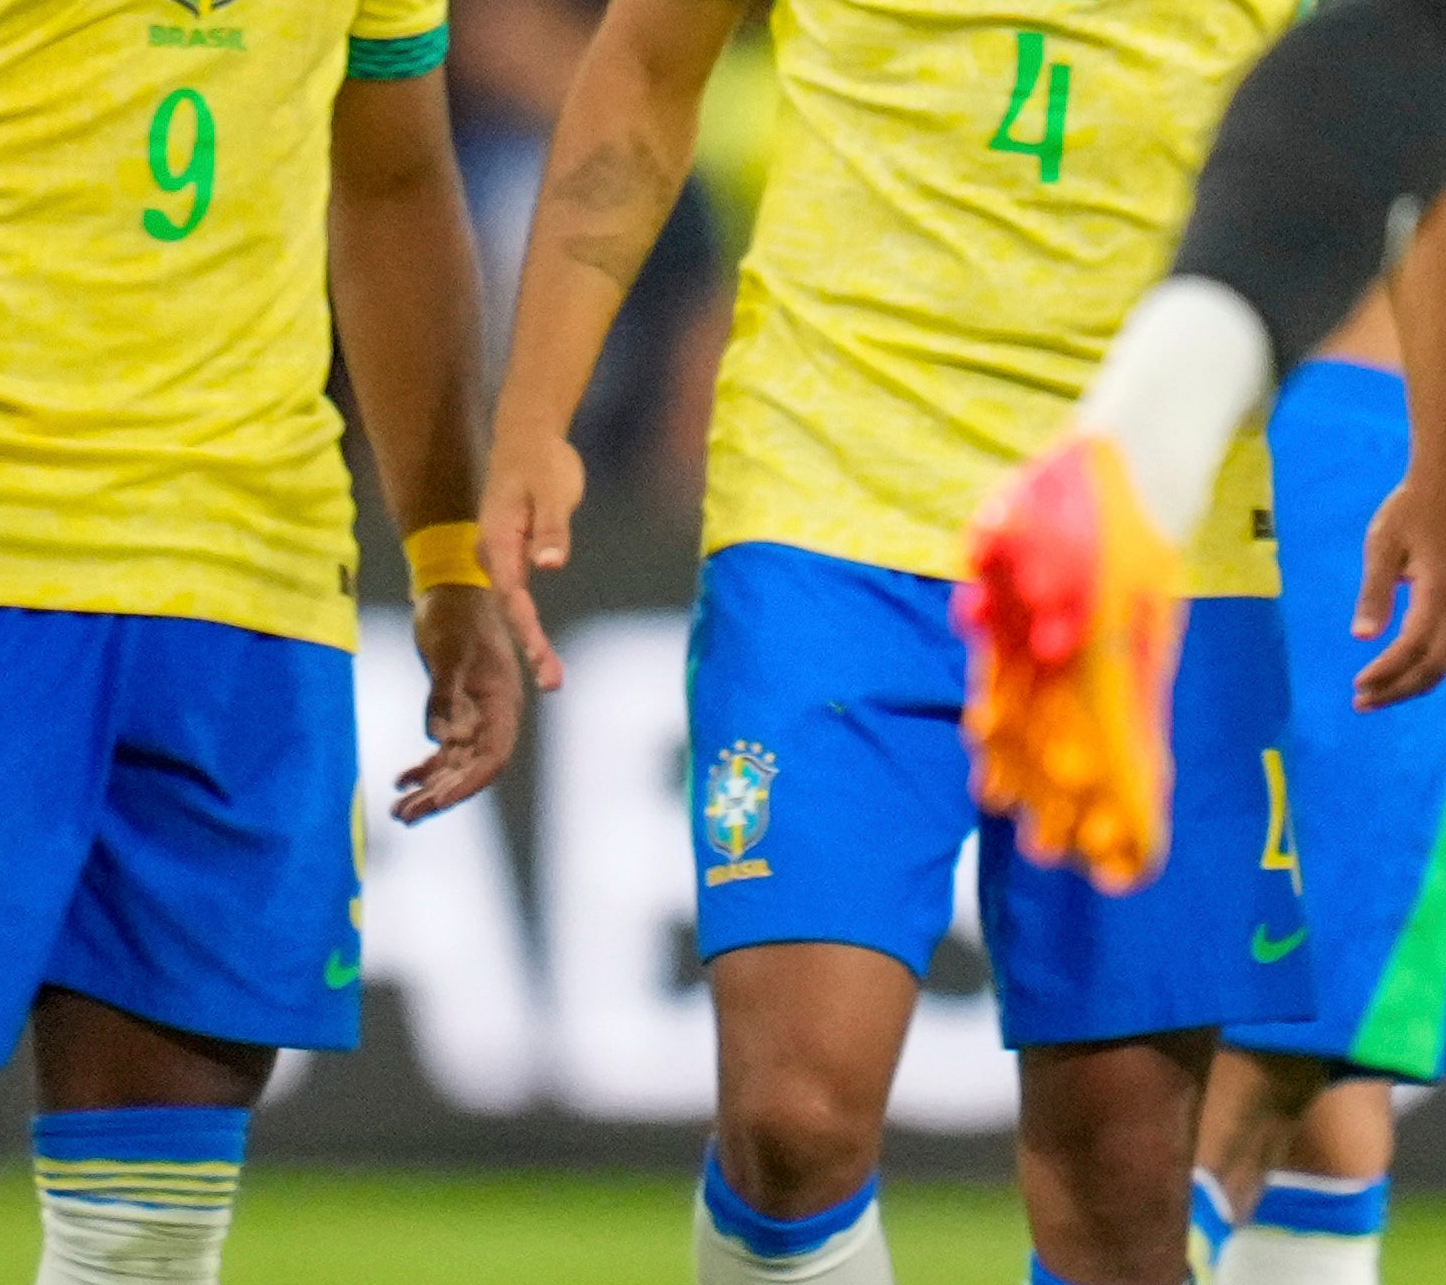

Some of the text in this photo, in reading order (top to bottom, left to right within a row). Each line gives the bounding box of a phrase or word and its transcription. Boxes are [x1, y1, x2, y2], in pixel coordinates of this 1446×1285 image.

[148, 24, 247, 51] BRASIL
[988, 30, 1072, 185] 4
[141, 87, 217, 243] 9
